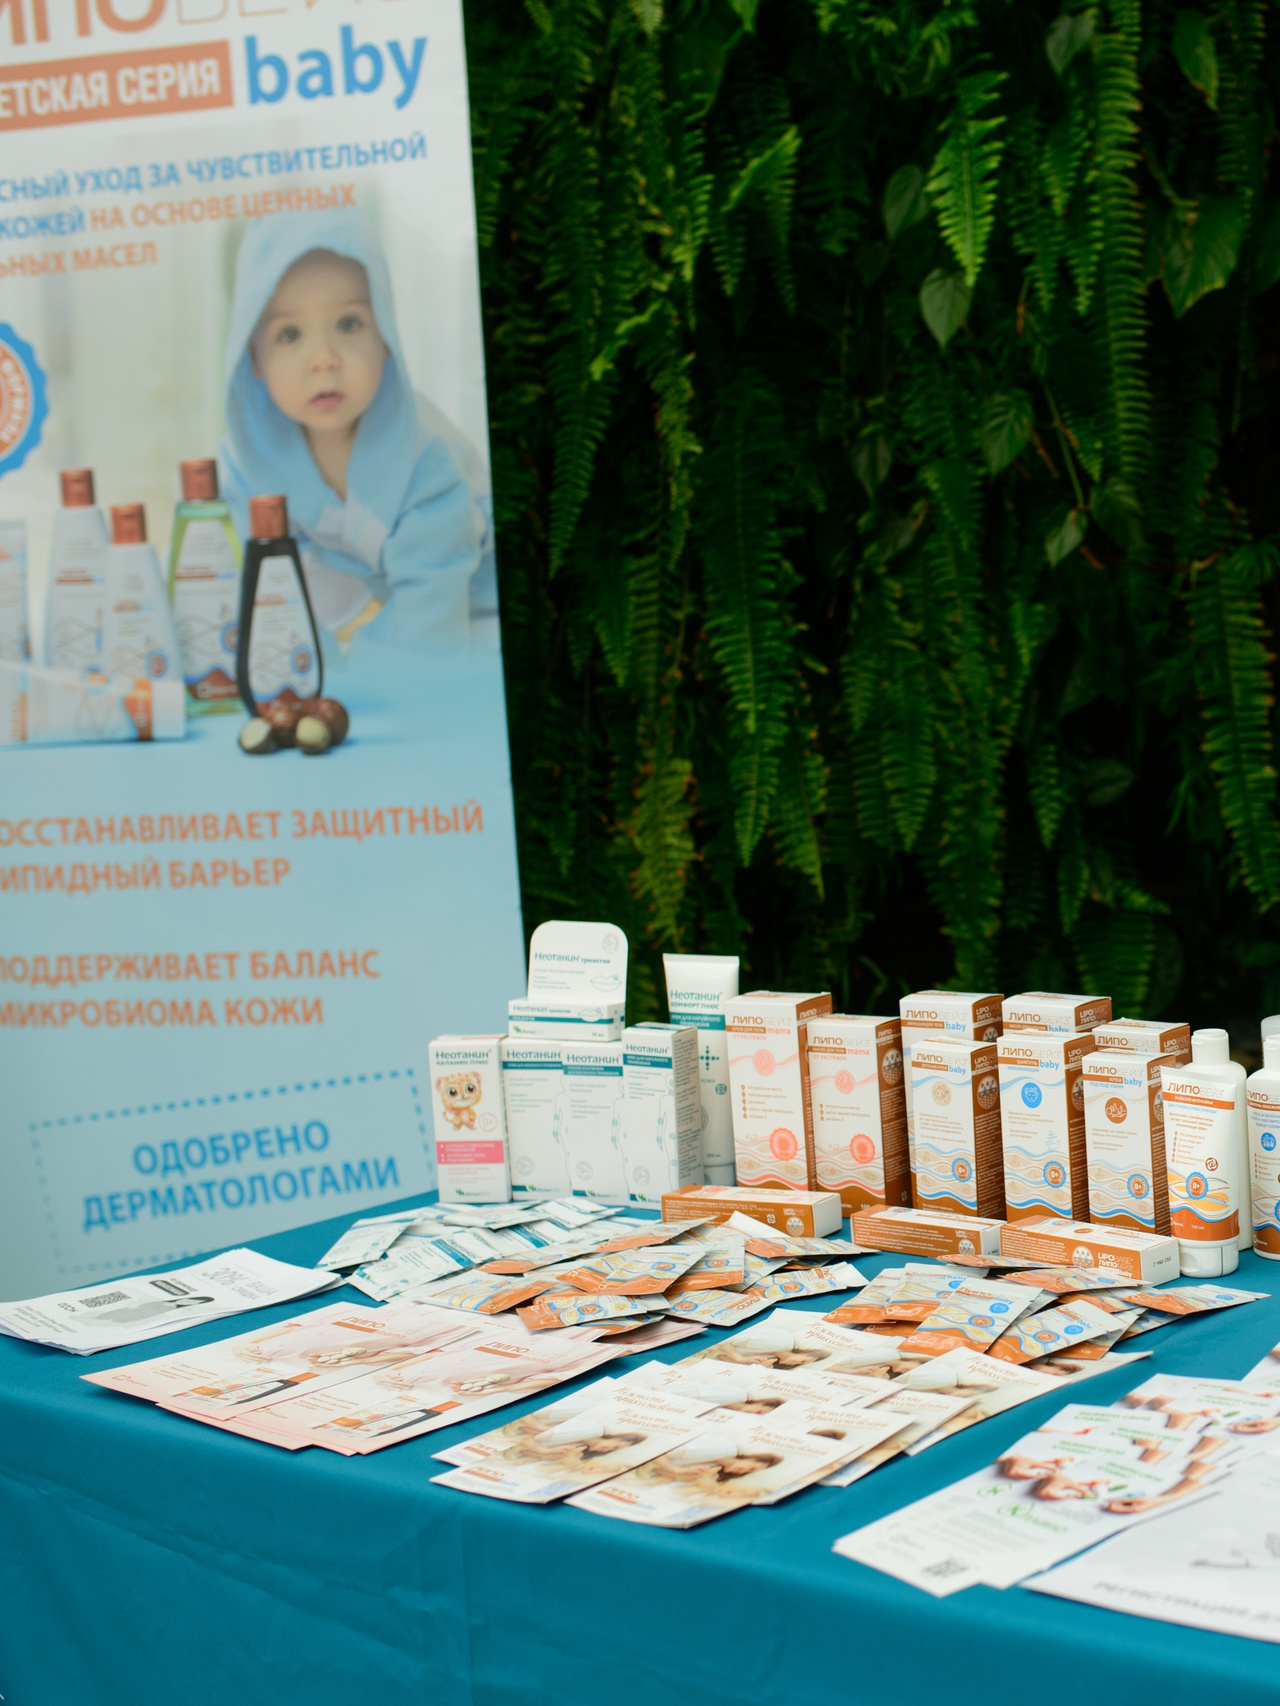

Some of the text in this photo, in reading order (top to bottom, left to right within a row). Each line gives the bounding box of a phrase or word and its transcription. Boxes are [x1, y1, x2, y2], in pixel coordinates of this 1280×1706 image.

[244, 25, 428, 111] baby
[117, 58, 221, 104] СЕРИЯ
[0, 132, 428, 201] СНЫЙ УХОД ЗА ЧУВСТВИТЕЛЬНОЙ
[0, 183, 358, 241] КОЖЕЙ НА ОСНОВЕ ЦЕННЫХ
[72, 241, 158, 272] МАСЕЛ
[0, 799, 484, 848] ОССТАНАВЛИВАЕТ ЗАЩИТНЫЙ
[0, 857, 291, 895] ИПИДНЫЙ БАРЬЕР
[534, 952, 580, 964] Неотанин
[0, 949, 381, 988] ПОДДЕРЖИВАЕТ БАЛАНС
[670, 990, 721, 1002] Неотанин
[0, 997, 324, 1029] МИКРОБИОМА КОЖИ
[906, 1010, 968, 1020] ЛИПОБЕЙЗ
[1009, 1012, 1071, 1024] ЛИПОБЕЙЗ
[732, 1015, 793, 1026] ЛИПОБЕЙЗ
[946, 1021, 966, 1032] baby
[767, 1027, 791, 1035] mama
[1048, 1025, 1069, 1033] baby
[813, 1036, 871, 1048] ЛИПОБЕЙЗ
[1097, 1035, 1157, 1049] ЛИПОБЕЙЗ
[506, 1049, 561, 1060] Неотанин
[626, 1044, 668, 1054] Неотанин
[847, 1048, 870, 1056] mama
[1002, 1047, 1061, 1060] ЛИПОБЕЙЗ
[436, 1051, 489, 1060] Неотанин
[567, 1054, 620, 1064] Неотанин
[916, 1053, 968, 1065] ЛИПОБЕЙЗ
[949, 1065, 966, 1075] baby
[1040, 1060, 1059, 1071] baby
[1088, 1065, 1144, 1078] ЛИПОБЕЙЗ
[1123, 1077, 1143, 1087] baby
[1167, 1082, 1224, 1099] ЛИПОБЕЙЗ
[132, 1119, 330, 1179] ОДОБРЕНО
[1192, 1181, 1202, 1190] 0+
[83, 1156, 401, 1234] ДЕРМАТОЛОГАМИ
[1098, 1252, 1133, 1264] LIPOBASE
[993, 1296, 1015, 1305] baby
